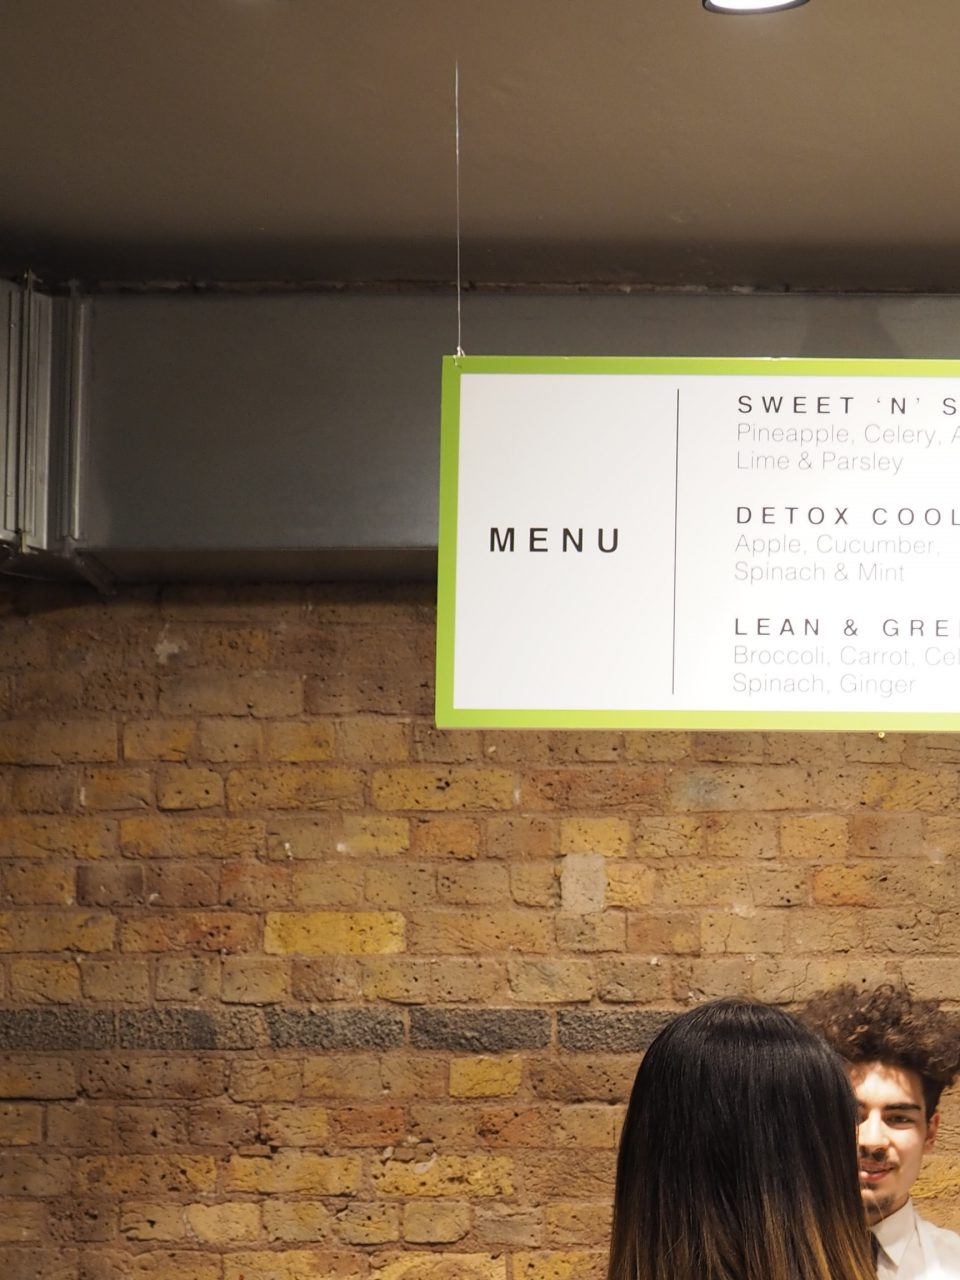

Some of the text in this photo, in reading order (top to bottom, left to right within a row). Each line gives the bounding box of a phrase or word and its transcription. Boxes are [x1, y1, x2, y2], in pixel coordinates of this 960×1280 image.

[738, 395, 854, 414] SWEET
[738, 422, 854, 448] Pineapple,
[865, 424, 941, 448] Celery,
[737, 450, 904, 475] Lime & Parsley
[737, 507, 848, 525] DETOX
[490, 527, 618, 553] MENU
[734, 534, 940, 558] Apple, Cucumber,
[734, 560, 904, 586] Spinach & Mint
[735, 618, 819, 636] LEAN
[844, 619, 858, 636] &
[734, 645, 830, 666] Broccoli,
[840, 673, 916, 698] Ginger
